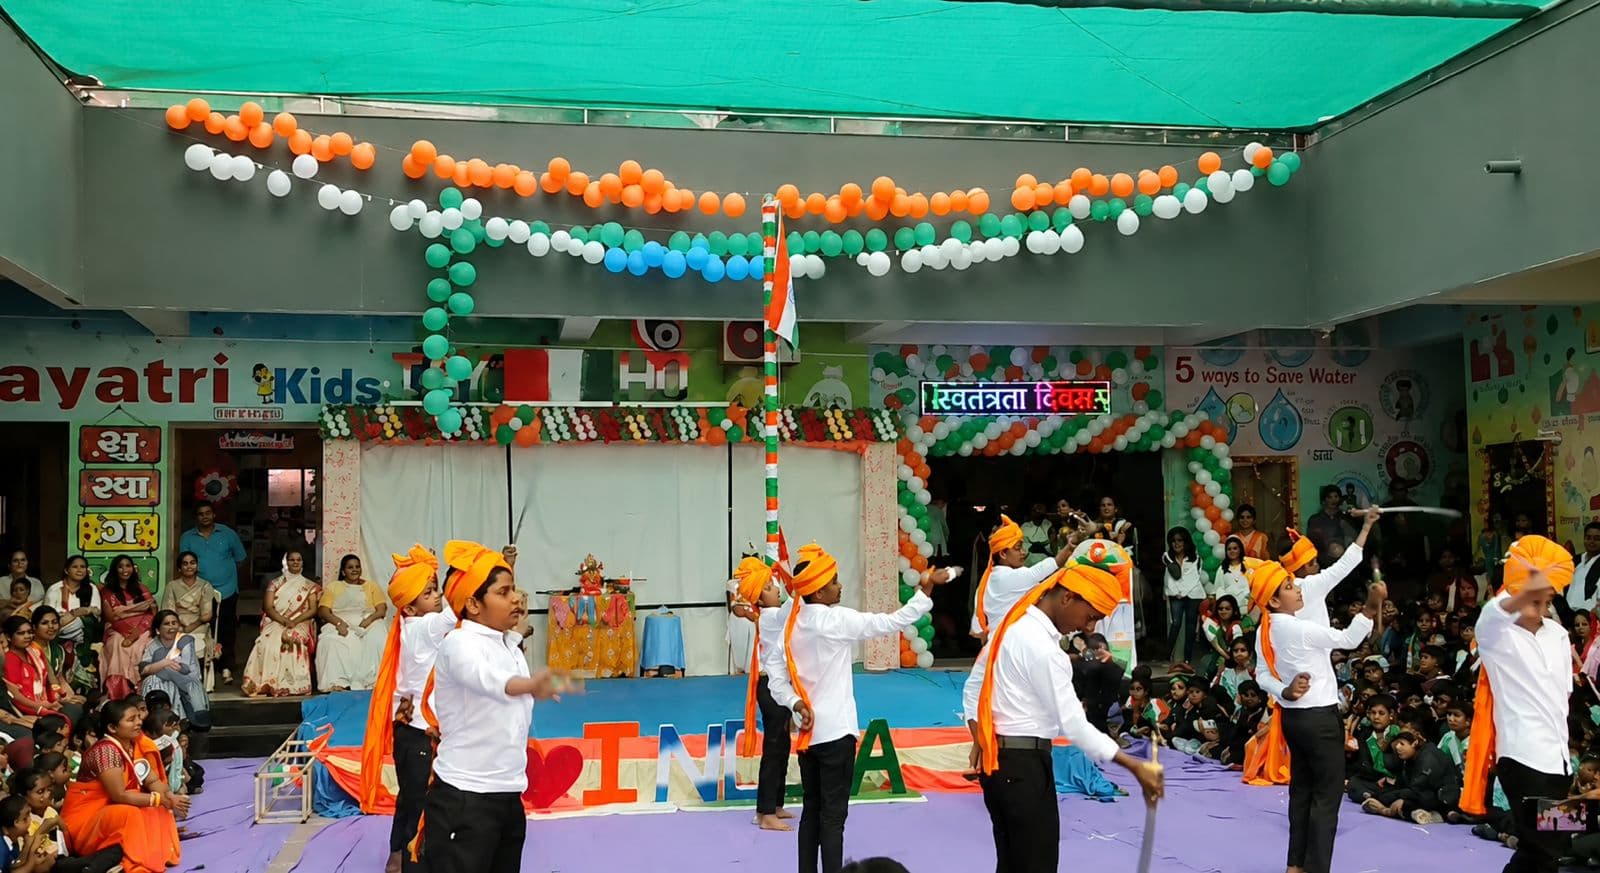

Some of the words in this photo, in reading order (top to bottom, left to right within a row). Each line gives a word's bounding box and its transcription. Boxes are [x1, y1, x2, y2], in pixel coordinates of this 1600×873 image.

[0, 352, 229, 410] ayatri
[274, 366, 381, 404] Kids
[1175, 356, 1195, 384] 5
[1202, 370, 1239, 388] ways
[1245, 367, 1260, 384] to
[1266, 366, 1304, 384] Save
[1309, 367, 1357, 385] Water
[582, 718, 907, 805] INDA
